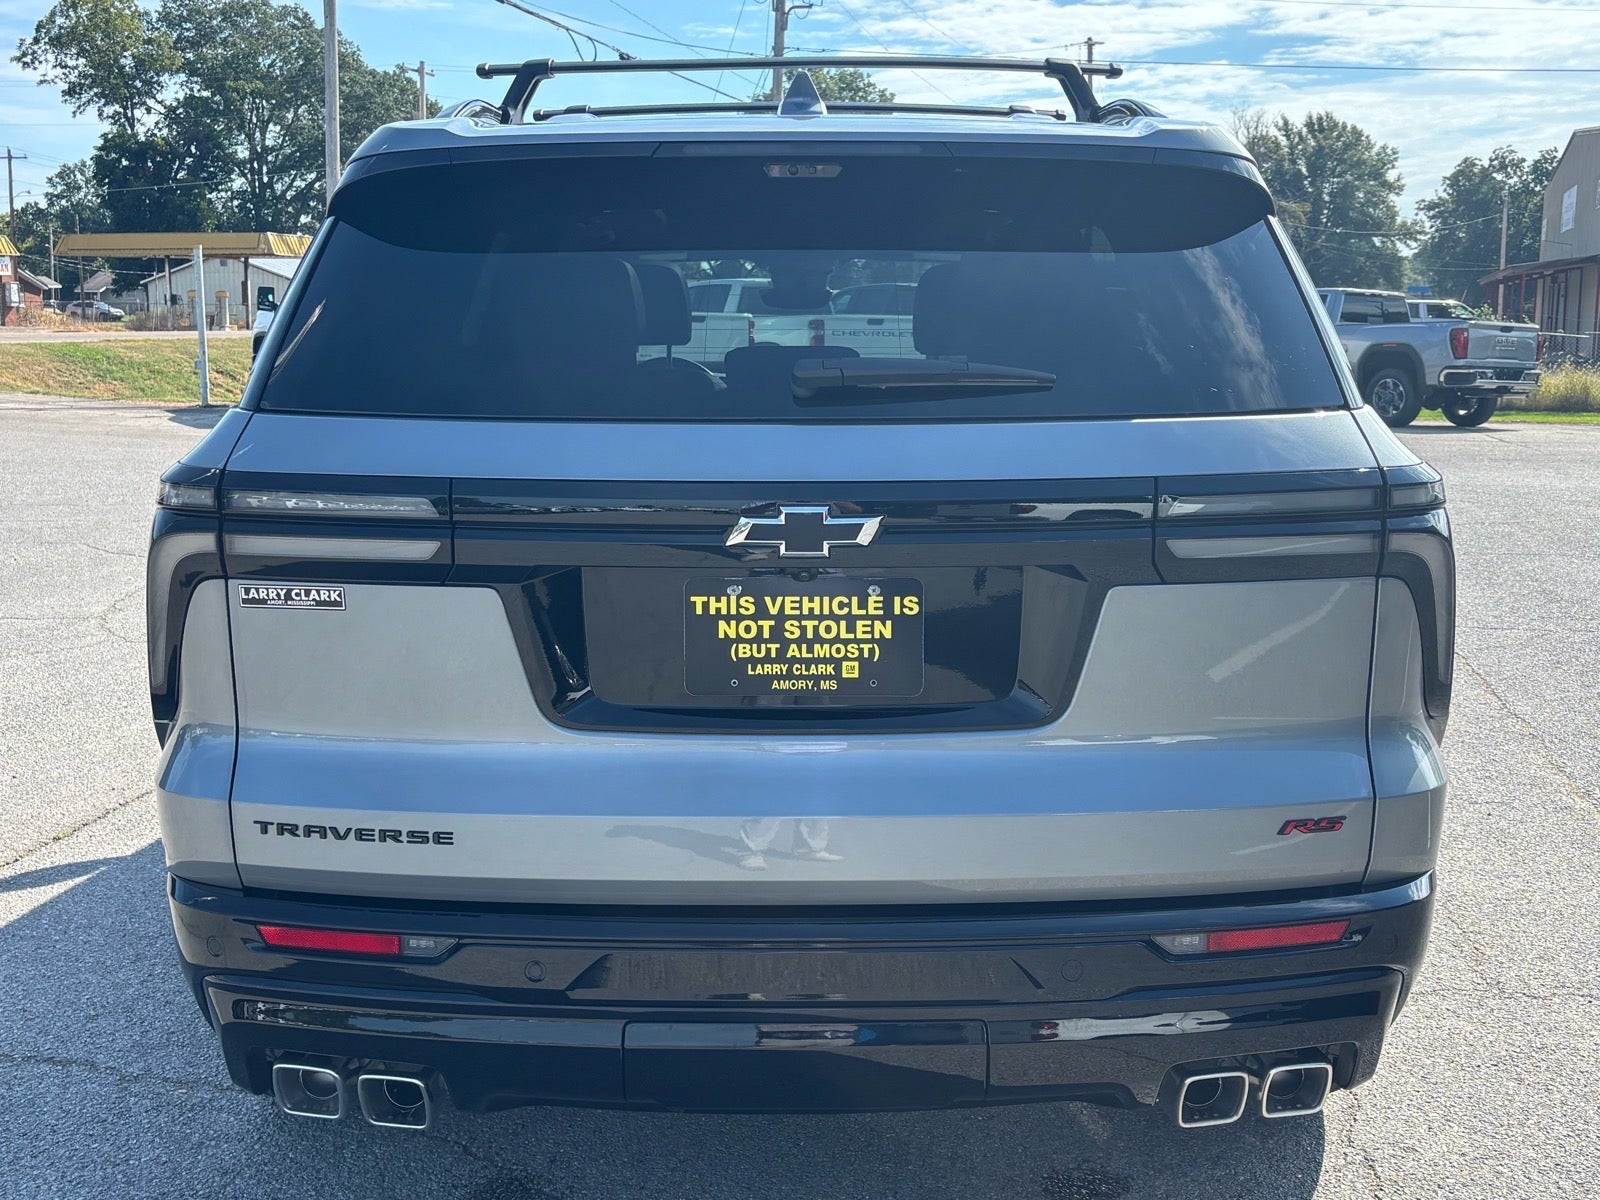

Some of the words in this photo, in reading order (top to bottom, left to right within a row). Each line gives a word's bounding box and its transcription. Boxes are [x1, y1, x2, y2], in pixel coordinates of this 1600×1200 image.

[241, 588, 287, 600] LARRY
[291, 589, 341, 601] CLARK
[690, 596, 756, 615] THIS
[764, 596, 884, 615] VEHICLE
[893, 596, 920, 615] IS
[718, 620, 775, 639] NOT
[783, 620, 892, 639] STOLEN
[730, 643, 780, 661] (BUT
[786, 643, 880, 661] ALMOST)
[747, 663, 789, 676] LARRY
[792, 663, 836, 676] CLARK
[771, 680, 817, 692] AMORY,
[820, 680, 838, 690] MS
[253, 820, 455, 846] TRAVERSE
[1277, 815, 1347, 835] RS
